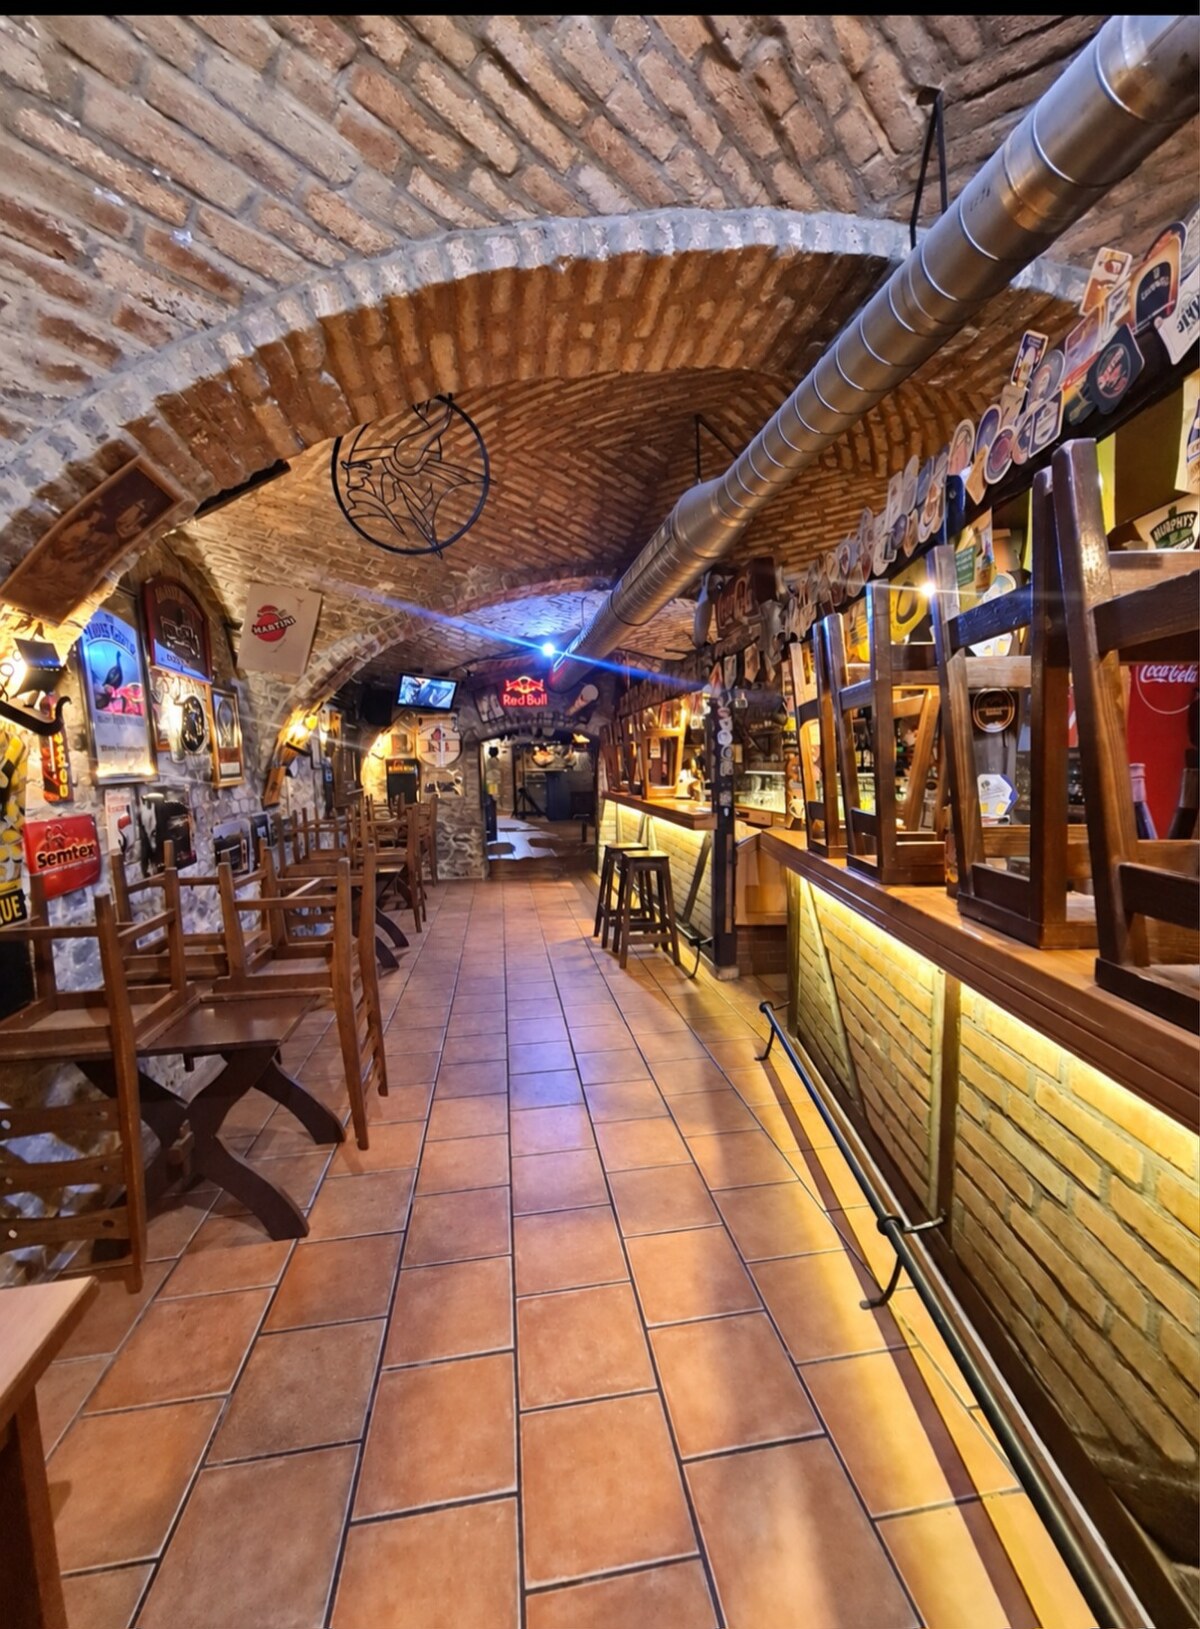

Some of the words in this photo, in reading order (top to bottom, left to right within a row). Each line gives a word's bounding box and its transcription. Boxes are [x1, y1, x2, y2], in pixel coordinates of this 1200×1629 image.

[252, 616, 296, 635] MARTINI
[503, 694, 525, 706] Red
[527, 693, 548, 706] Bull
[36, 843, 95, 869] Semtex
[0, 895, 23, 925] UE
